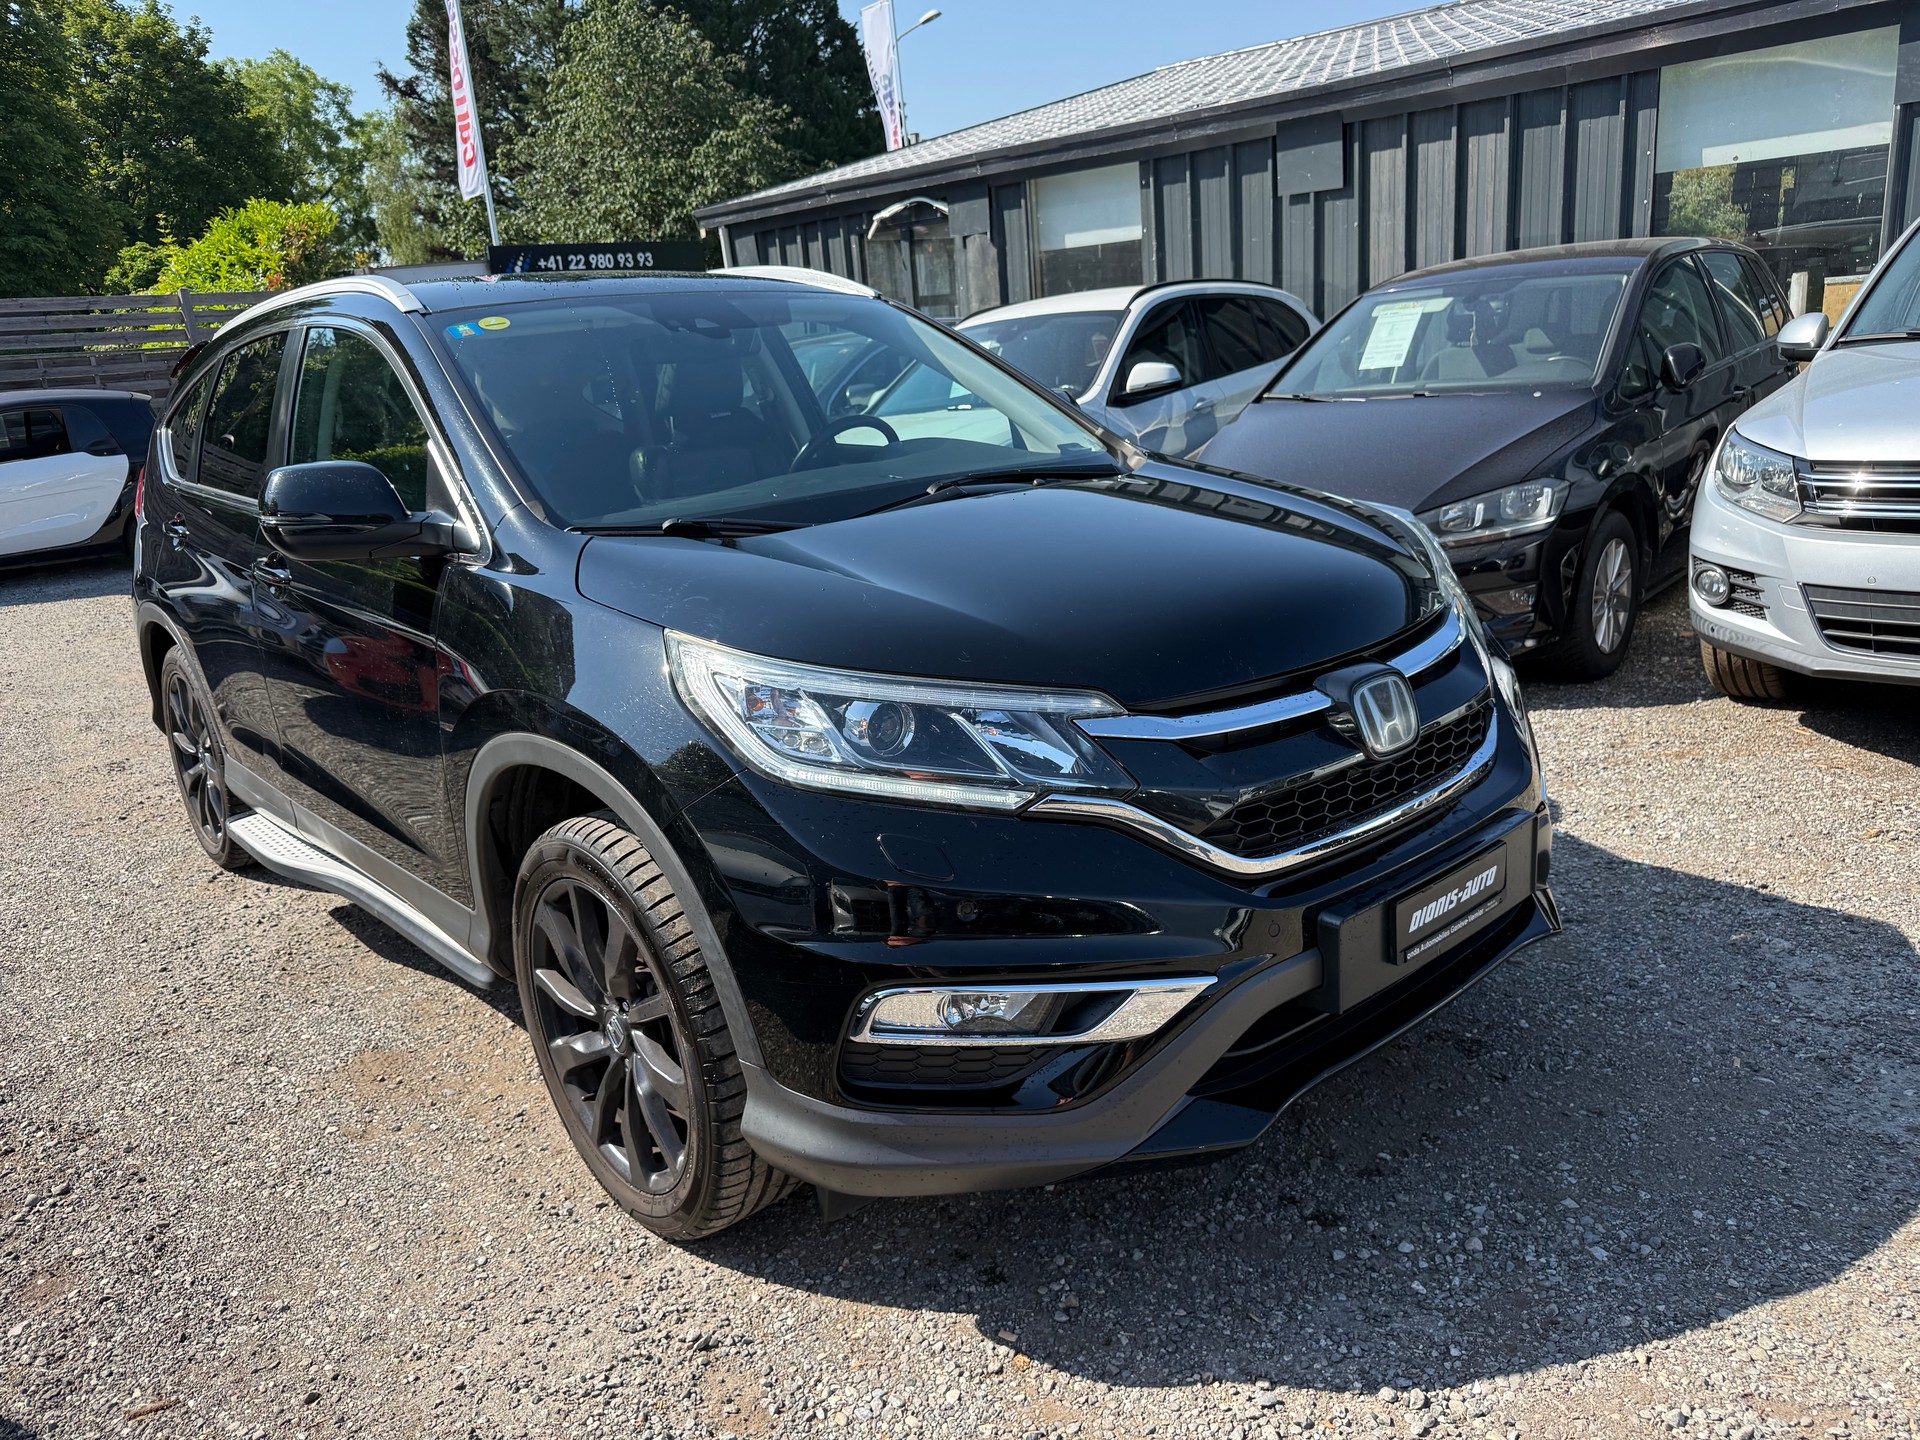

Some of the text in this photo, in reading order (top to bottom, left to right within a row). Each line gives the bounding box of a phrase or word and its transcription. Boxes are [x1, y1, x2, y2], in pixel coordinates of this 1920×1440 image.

[538, 251, 654, 271] +41 22 980 93 93
[1406, 947, 1420, 960] onda
[1421, 929, 1450, 951] Automobiles
